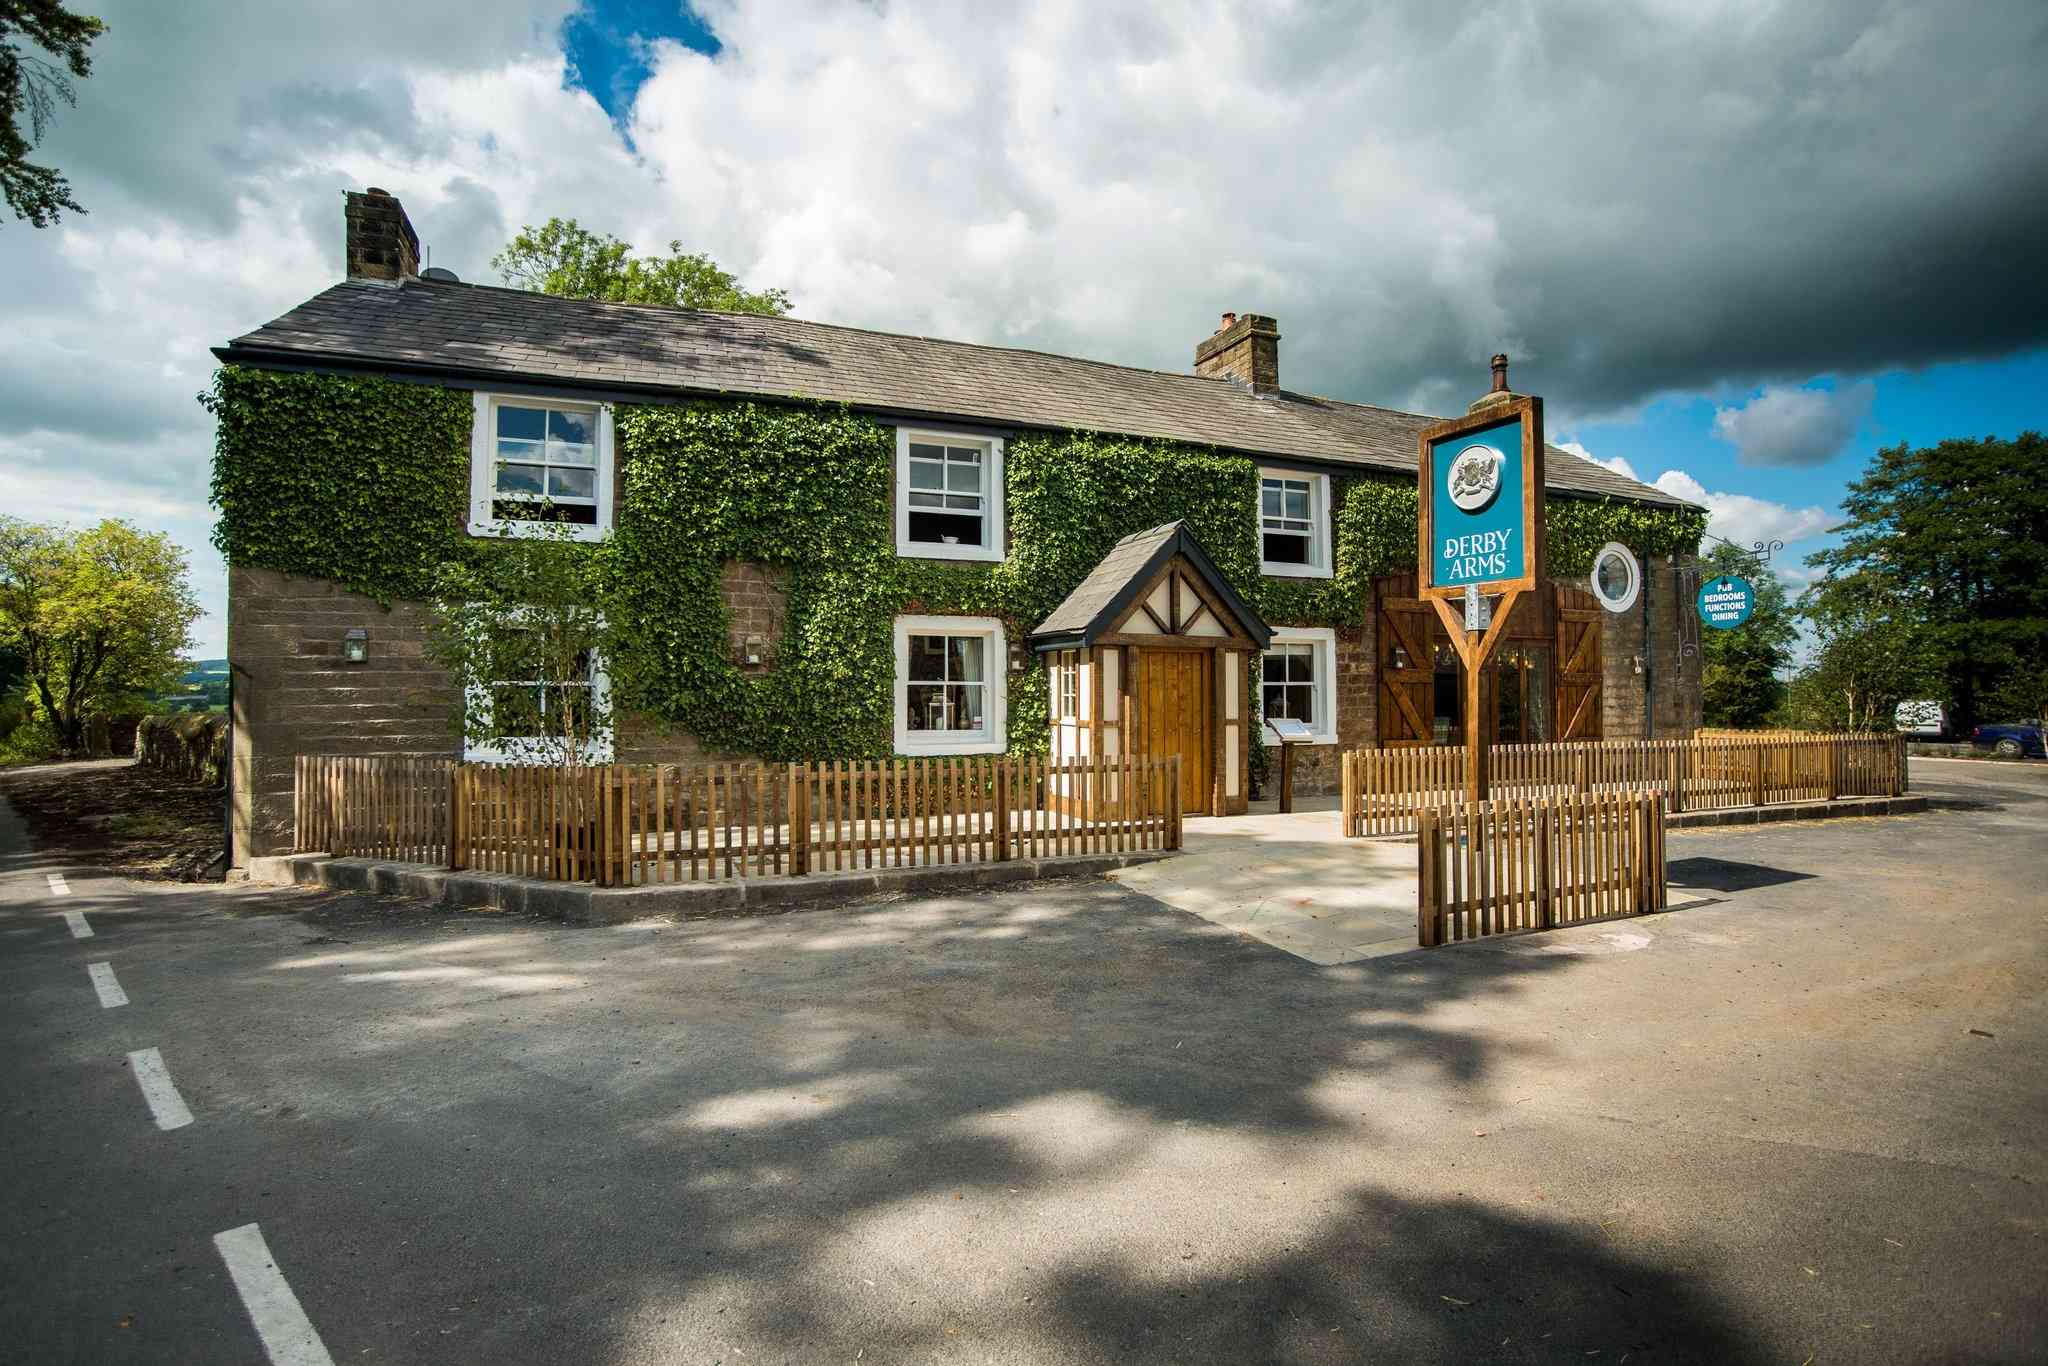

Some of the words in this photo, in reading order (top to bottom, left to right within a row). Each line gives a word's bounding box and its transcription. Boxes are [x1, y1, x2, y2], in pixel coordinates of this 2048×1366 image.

[1443, 528, 1512, 559] DERBY
[1449, 552, 1506, 579] ARMS
[1717, 583, 1733, 592] PUB
[1704, 592, 1746, 603] BEDROOMS
[1704, 601, 1746, 612] FUNCTIONS
[1712, 611, 1739, 621] DINING
